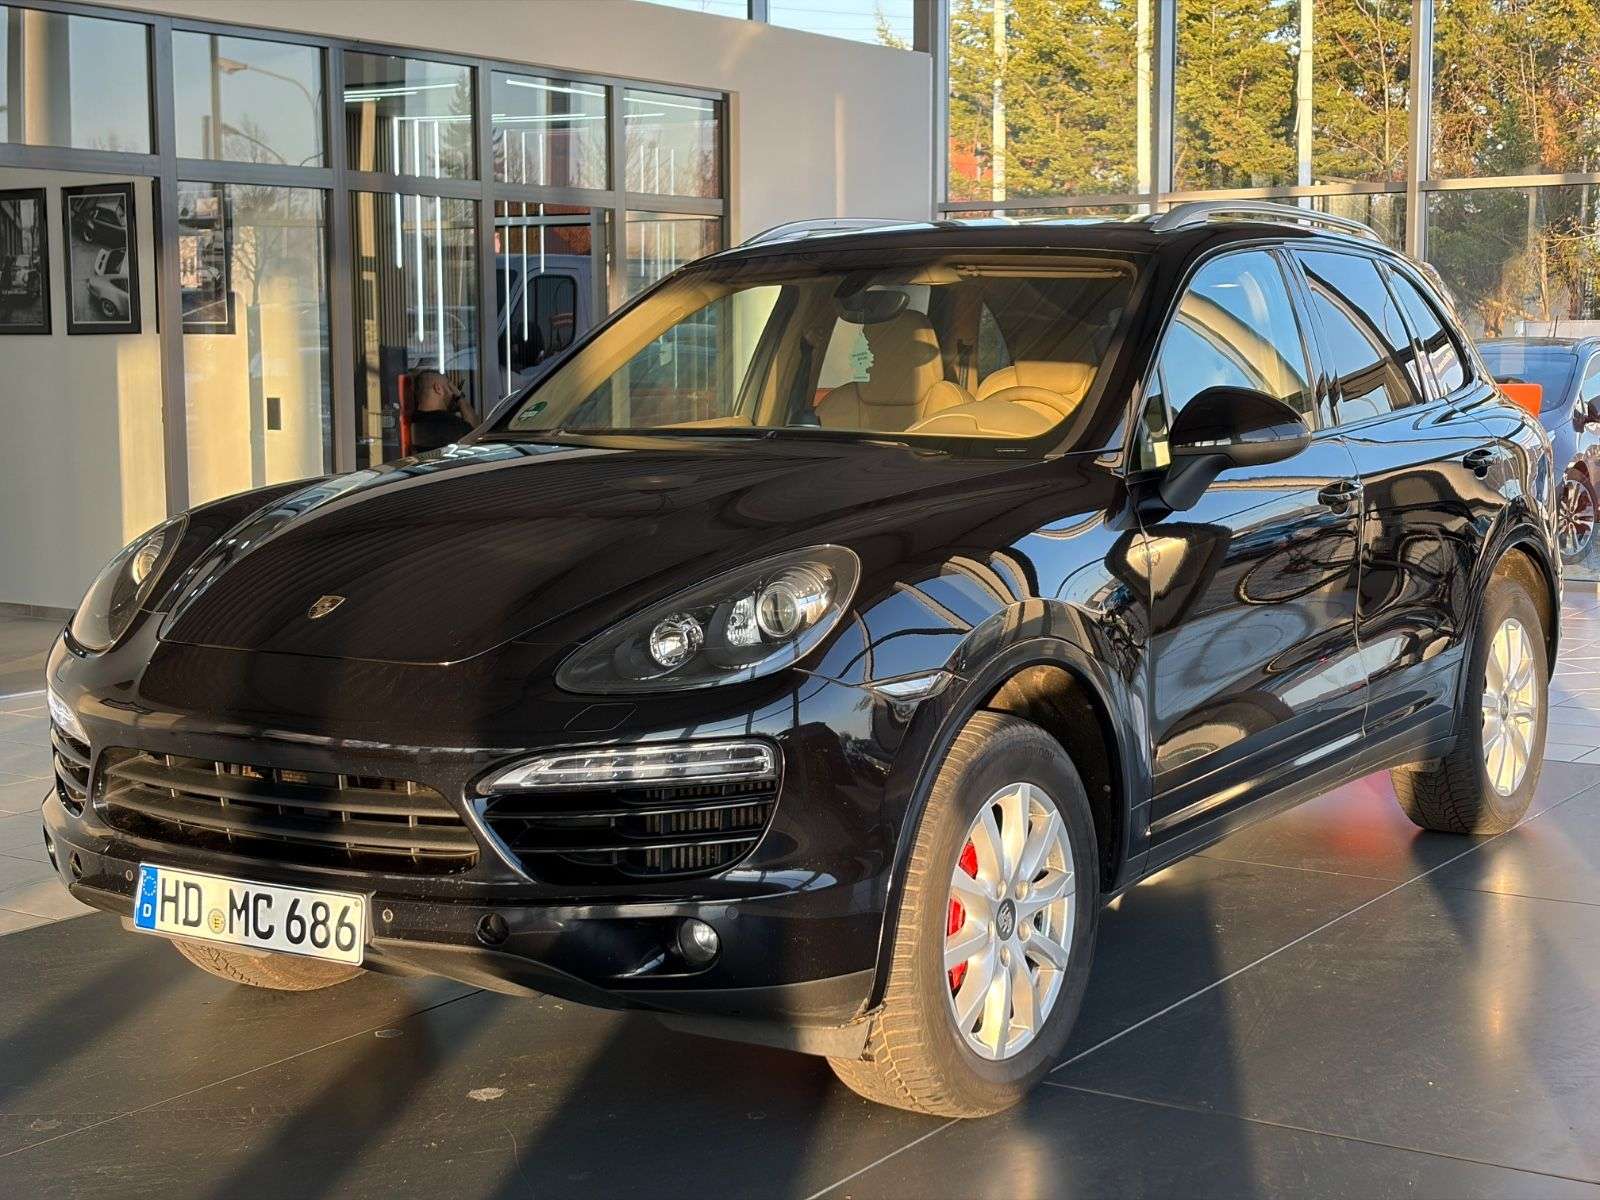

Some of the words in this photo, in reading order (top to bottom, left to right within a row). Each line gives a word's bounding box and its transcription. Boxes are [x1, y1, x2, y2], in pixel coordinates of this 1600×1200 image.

[143, 903, 152, 918] D
[160, 877, 203, 928] HD
[228, 888, 275, 940] MC
[285, 898, 357, 952] 686
